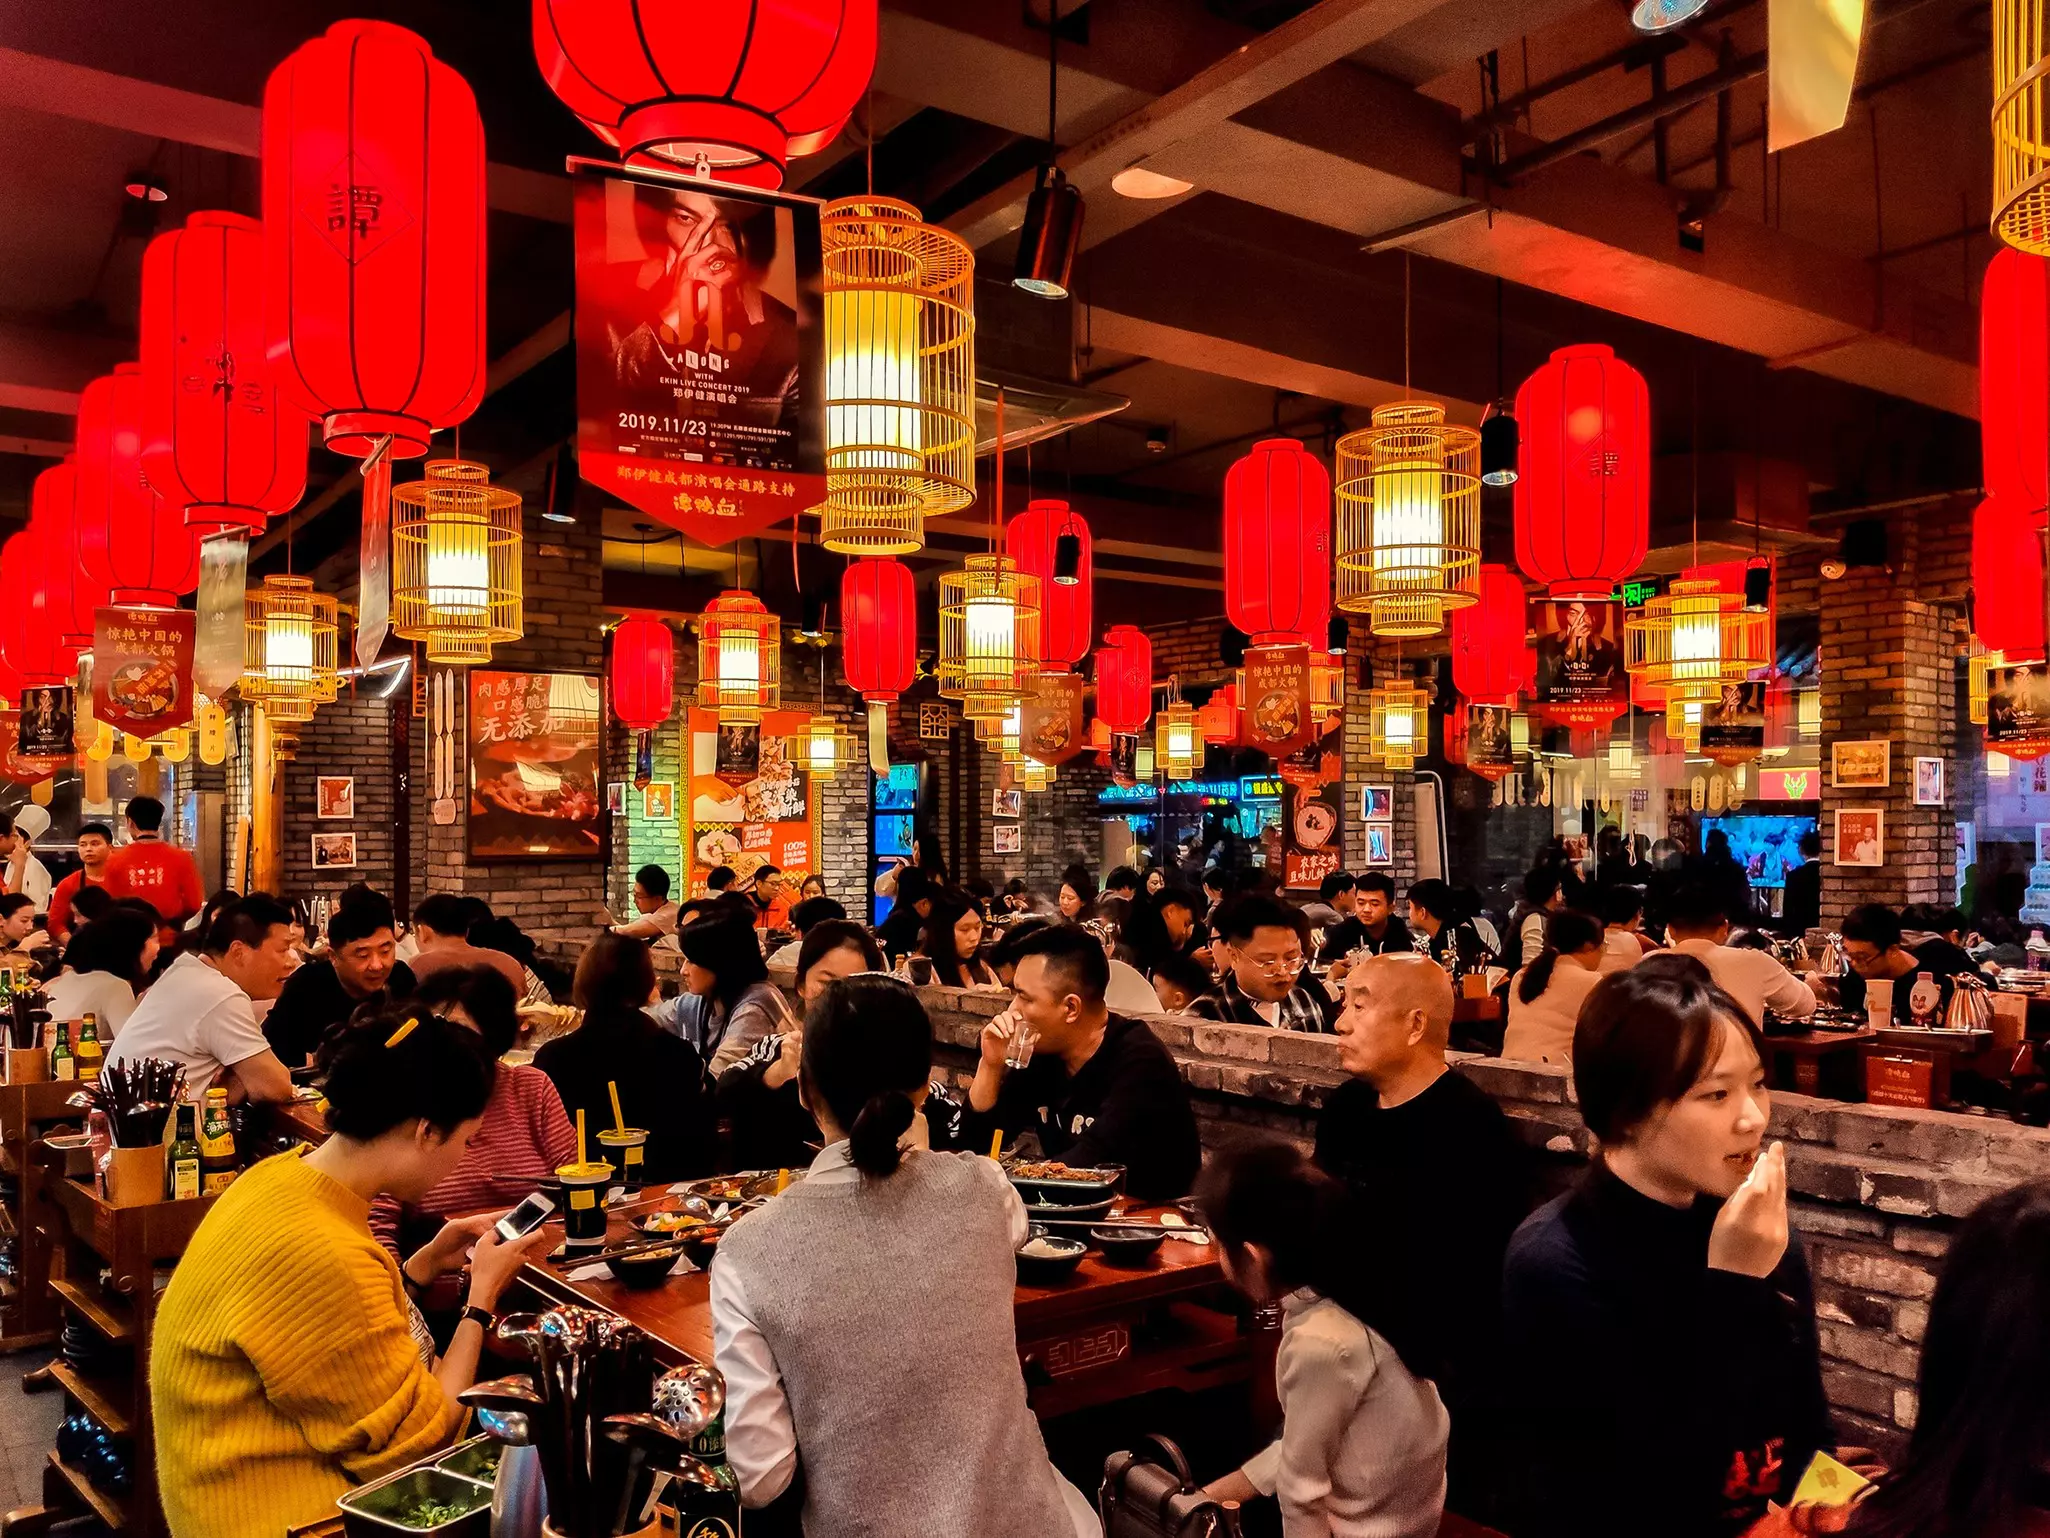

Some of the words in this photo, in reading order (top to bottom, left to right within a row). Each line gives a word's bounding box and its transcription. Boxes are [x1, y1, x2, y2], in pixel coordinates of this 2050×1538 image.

[694, 372, 714, 380] WITH
[659, 376, 678, 385] EKIN
[680, 379, 696, 388] LIVE
[698, 381, 732, 392] CONCERT
[733, 385, 750, 394] 2019
[673, 388, 738, 404] 郑伊健演唱会
[618, 412, 707, 436] 2019.11/23
[616, 465, 796, 498] 郑伊健成都演唱会通路支持
[106, 626, 183, 643] 惊艳中国的
[114, 642, 176, 657] 成都火锅
[1252, 664, 1302, 678] 惊艳中国的
[478, 676, 546, 697] 肉感厚足
[1258, 677, 1298, 689] 成都火锅
[478, 712, 566, 744] 无添加
[783, 840, 807, 852] 100%
[1300, 853, 1338, 868] 农家之味
